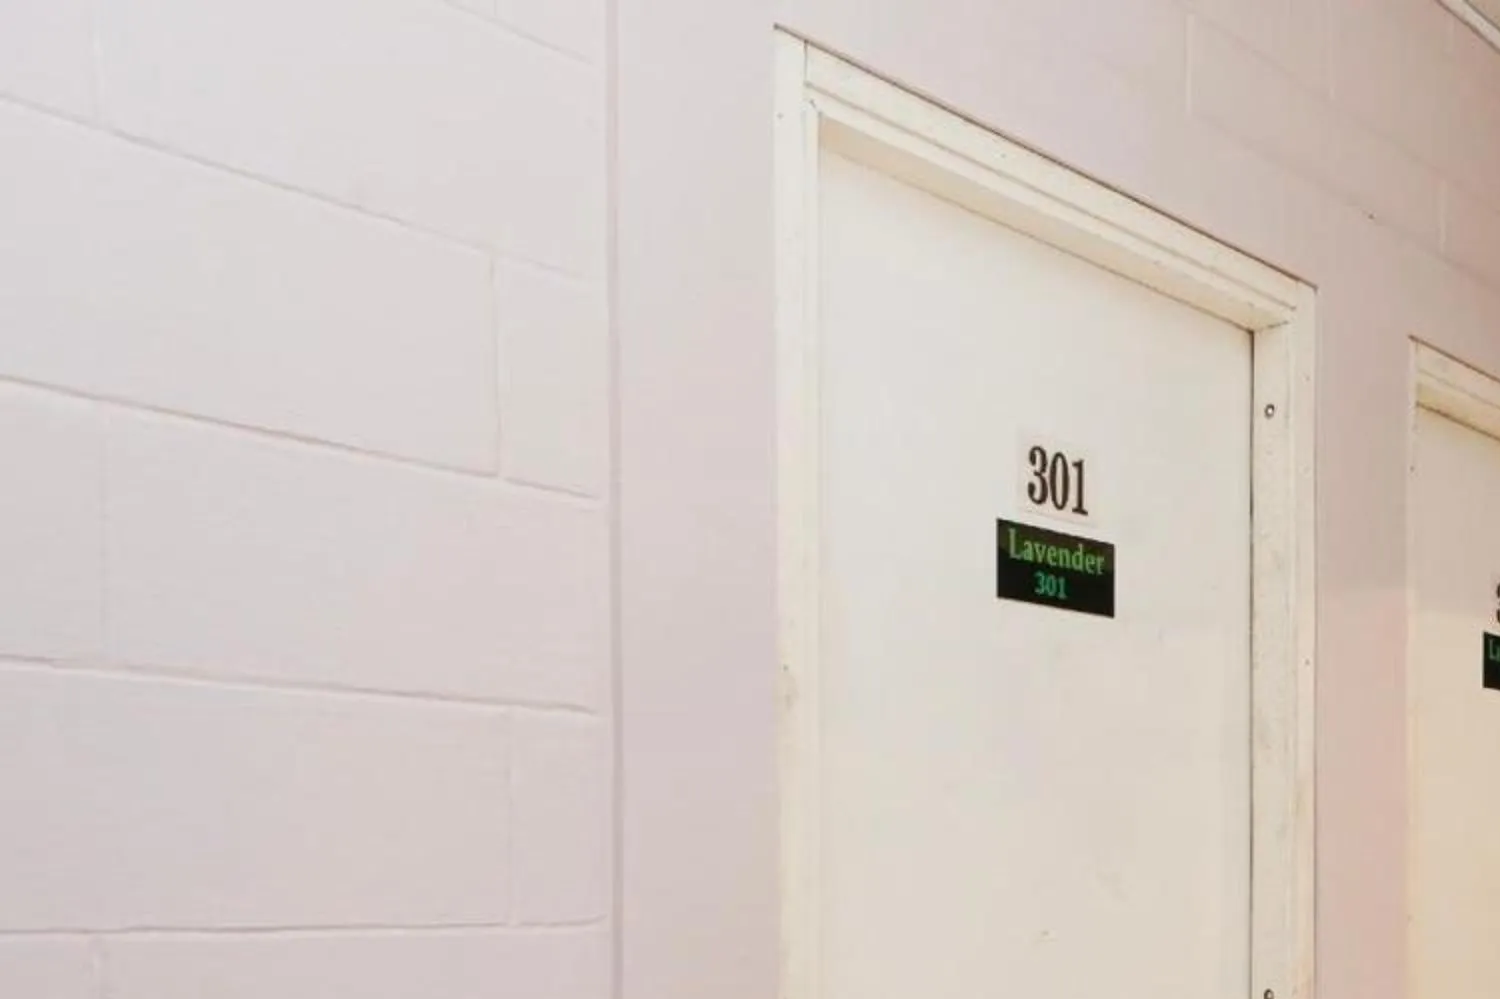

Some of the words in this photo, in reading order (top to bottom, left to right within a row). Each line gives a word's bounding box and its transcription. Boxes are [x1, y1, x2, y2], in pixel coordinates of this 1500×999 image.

[1027, 445, 1088, 515] 301
[1009, 528, 1105, 575] Lavender
[1034, 571, 1067, 599] 301
